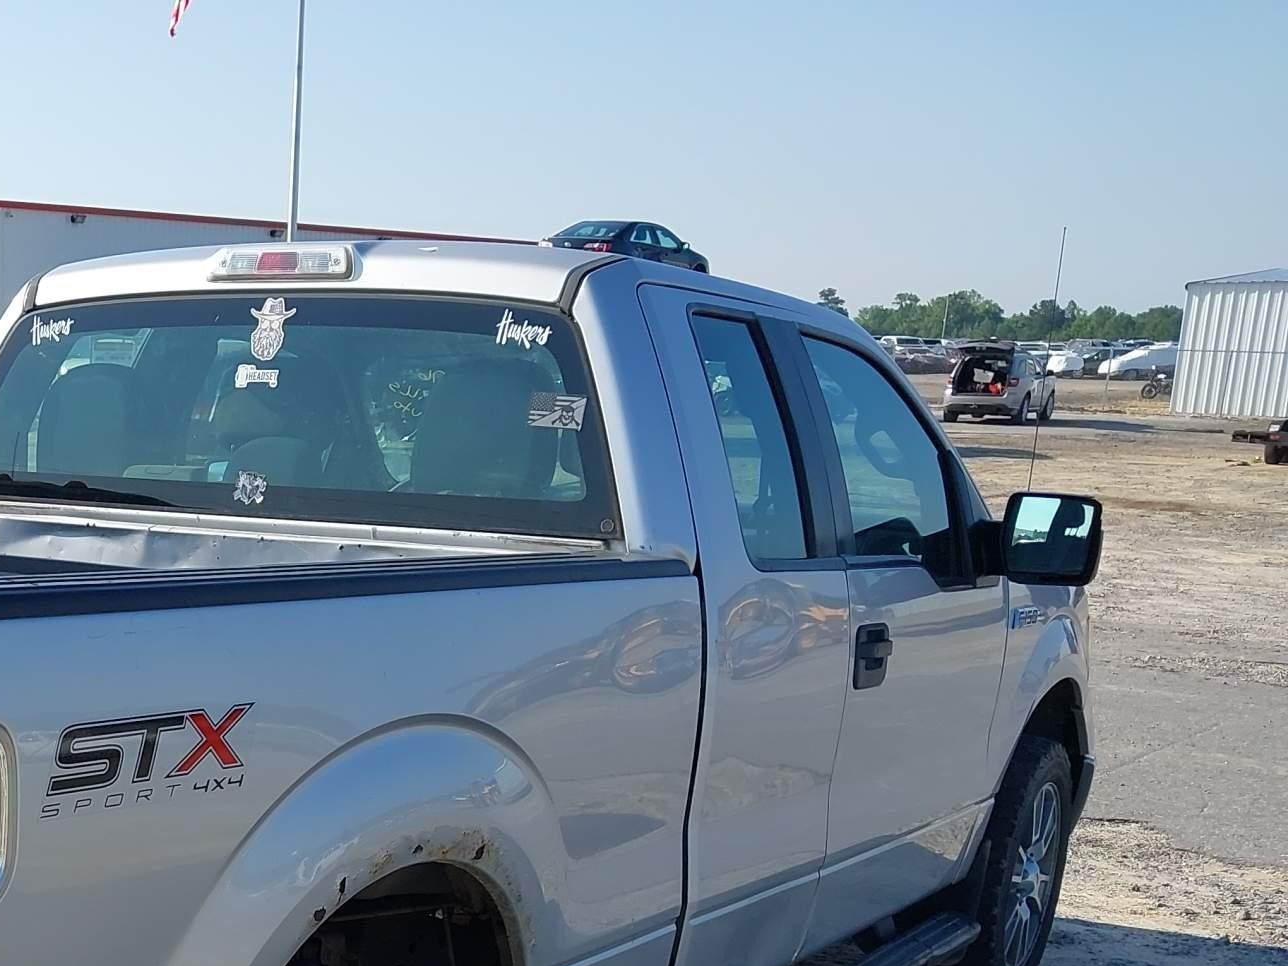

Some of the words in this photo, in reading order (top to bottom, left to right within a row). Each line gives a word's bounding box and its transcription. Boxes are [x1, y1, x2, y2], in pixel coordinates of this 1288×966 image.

[30, 315, 74, 346] Huskers
[496, 308, 552, 349] Huskers
[248, 371, 277, 381] HEADSET
[46, 701, 256, 797] STX
[40, 783, 182, 819] SPORT
